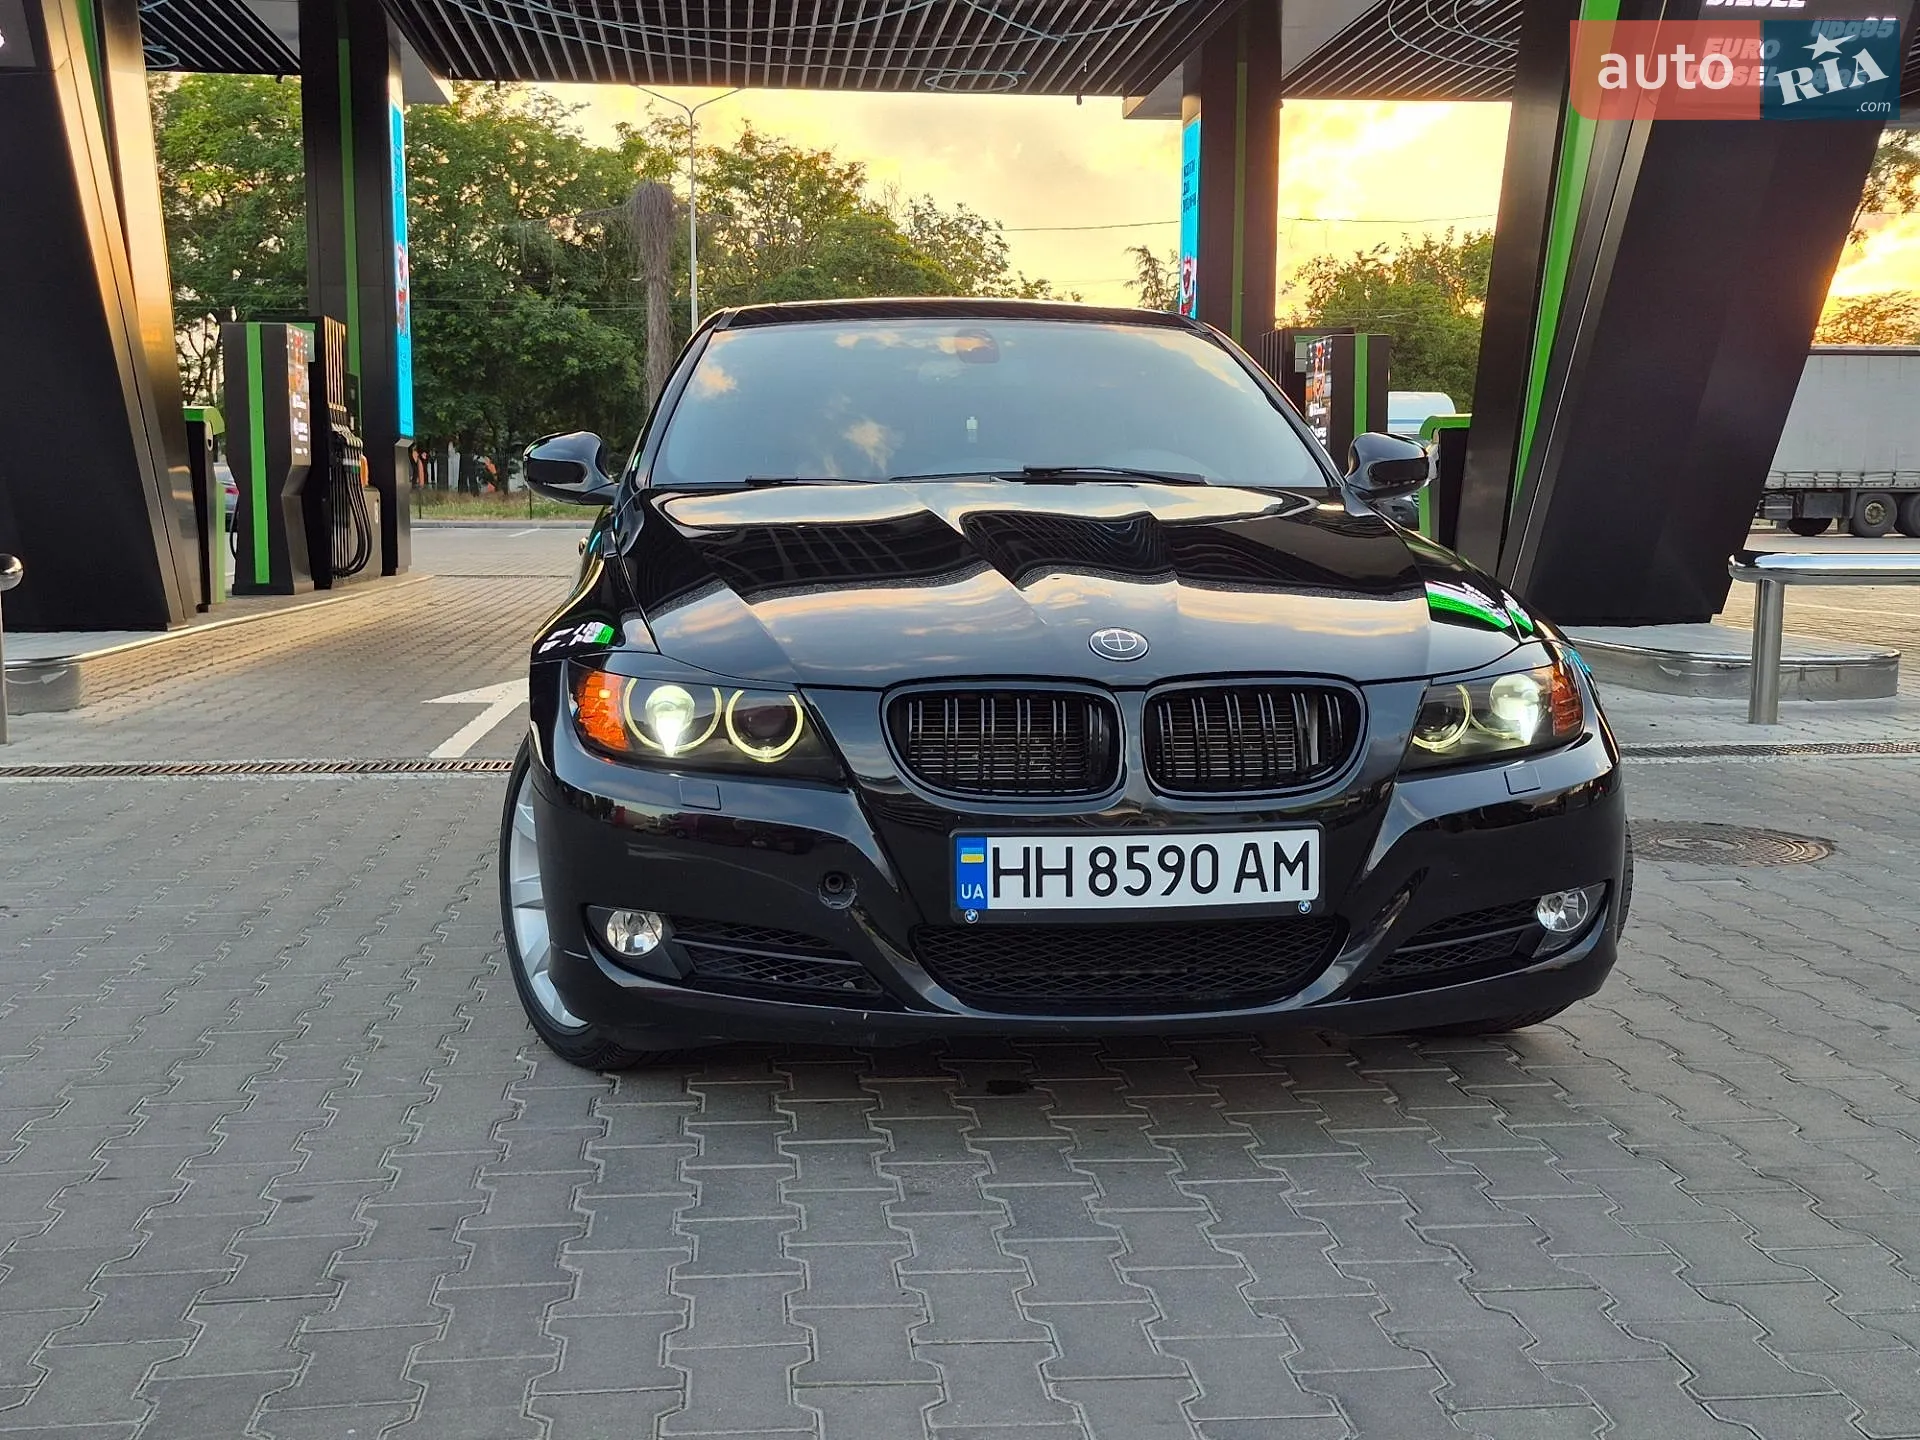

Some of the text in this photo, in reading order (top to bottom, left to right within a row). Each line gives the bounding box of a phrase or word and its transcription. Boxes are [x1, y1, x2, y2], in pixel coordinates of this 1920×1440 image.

[1703, 38, 1781, 60] EURO
[992, 840, 1310, 898] HH 8590 AM
[961, 883, 984, 899] UA
